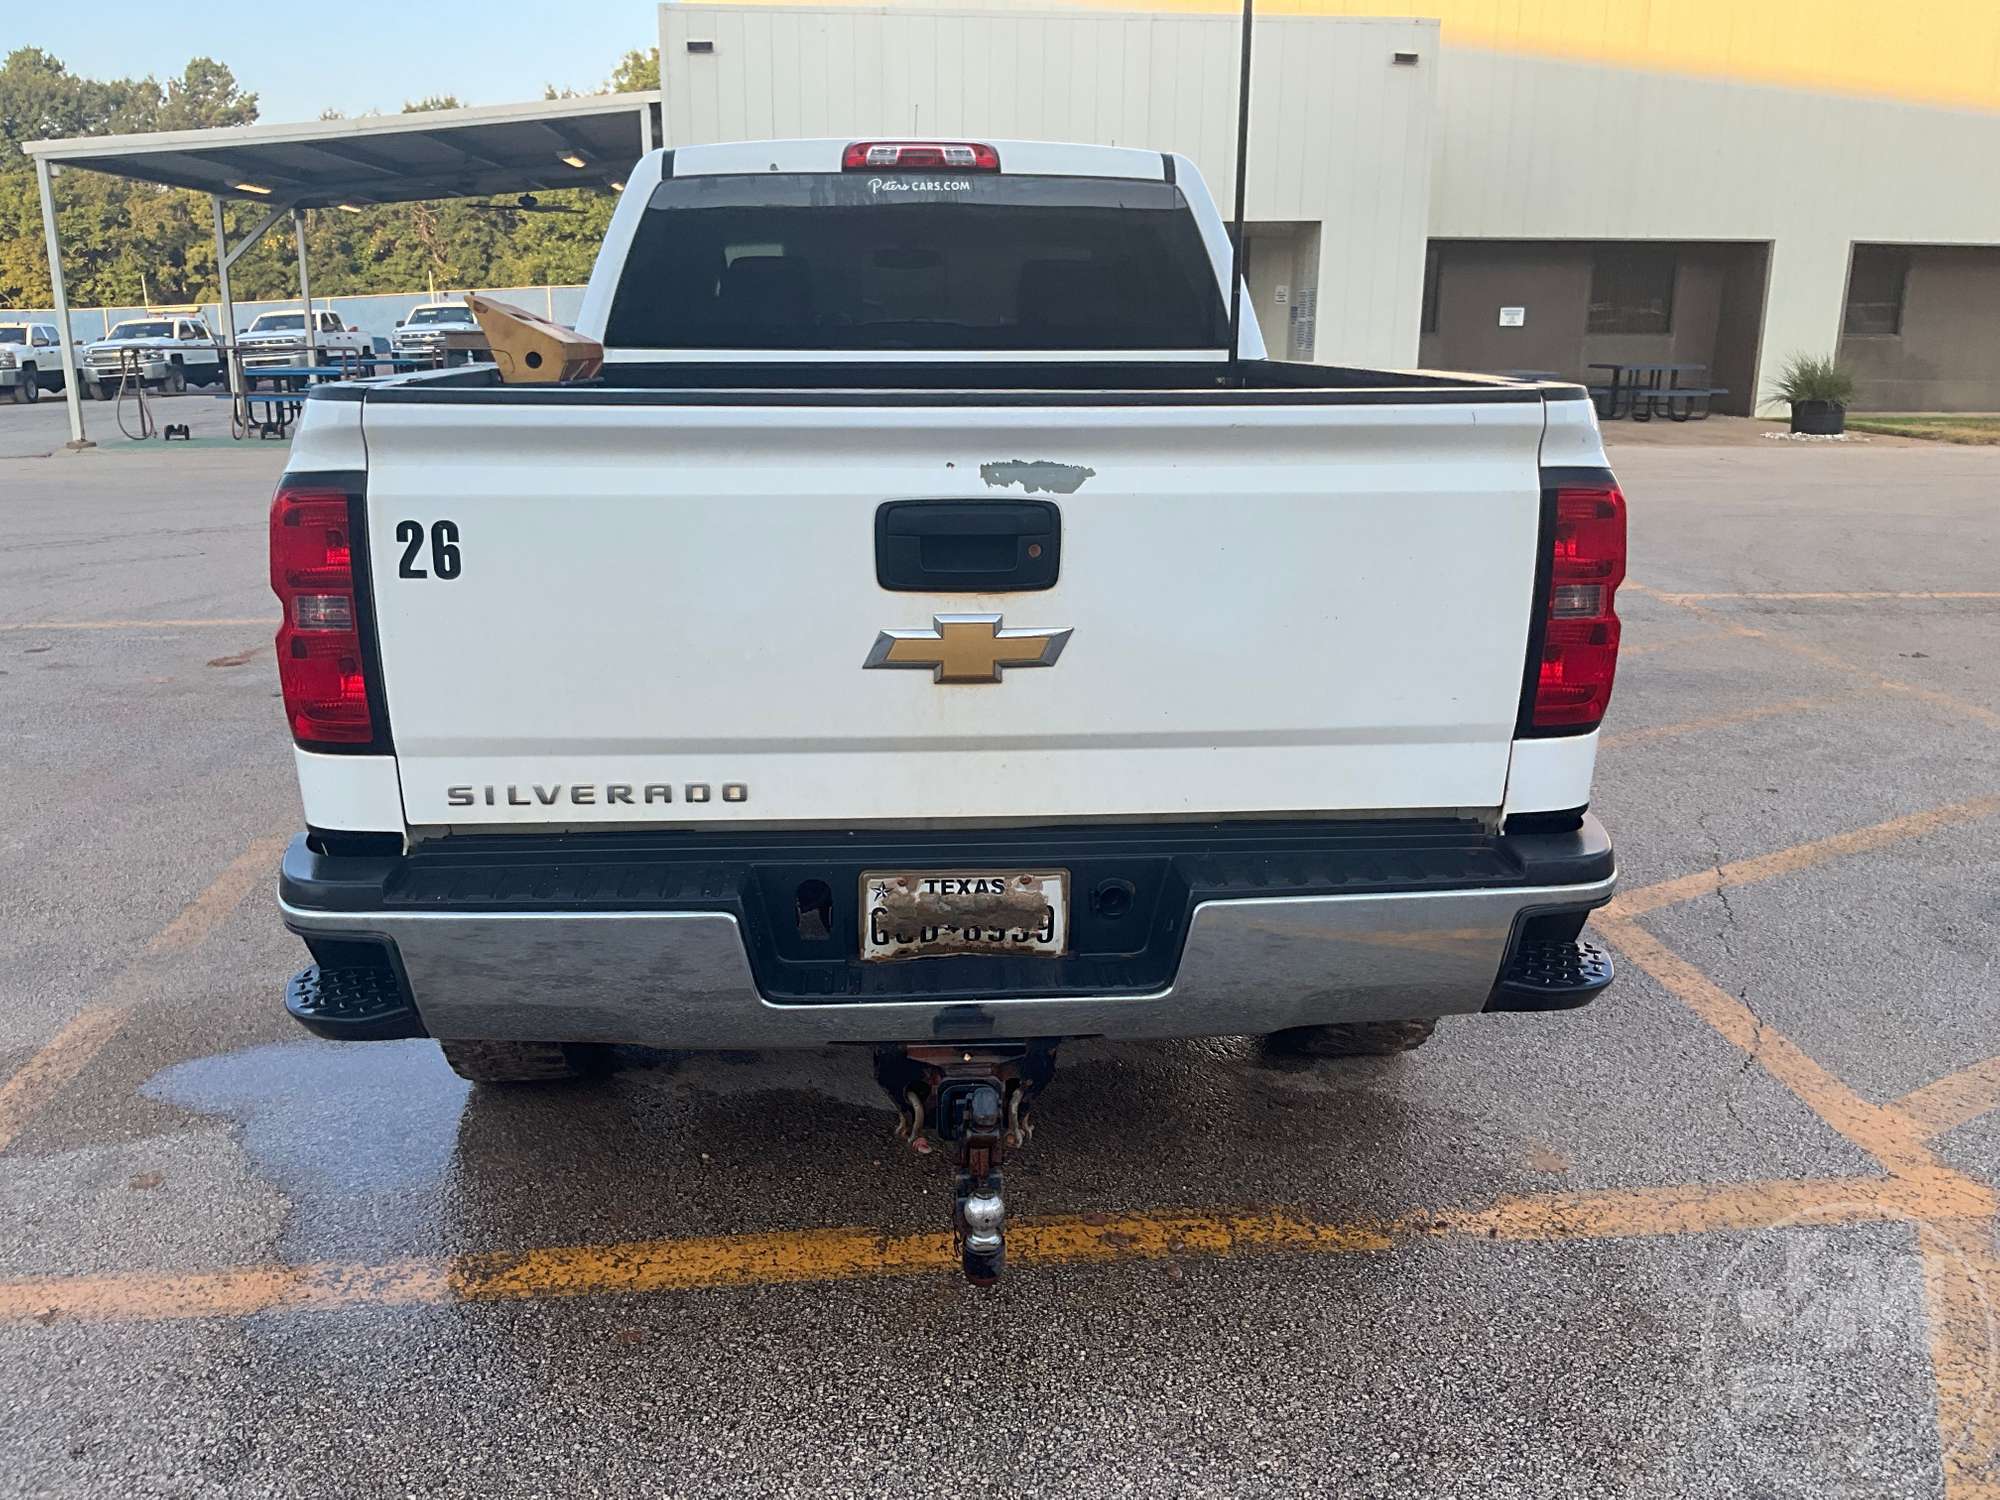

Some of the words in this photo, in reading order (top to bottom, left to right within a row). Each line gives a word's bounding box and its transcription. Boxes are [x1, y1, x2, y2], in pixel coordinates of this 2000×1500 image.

[867, 178, 910, 194] Peters
[911, 181, 970, 191] CARS.COM
[396, 519, 462, 580] 26
[447, 782, 748, 806] SILVERADO
[924, 878, 1005, 895] TEXAS
